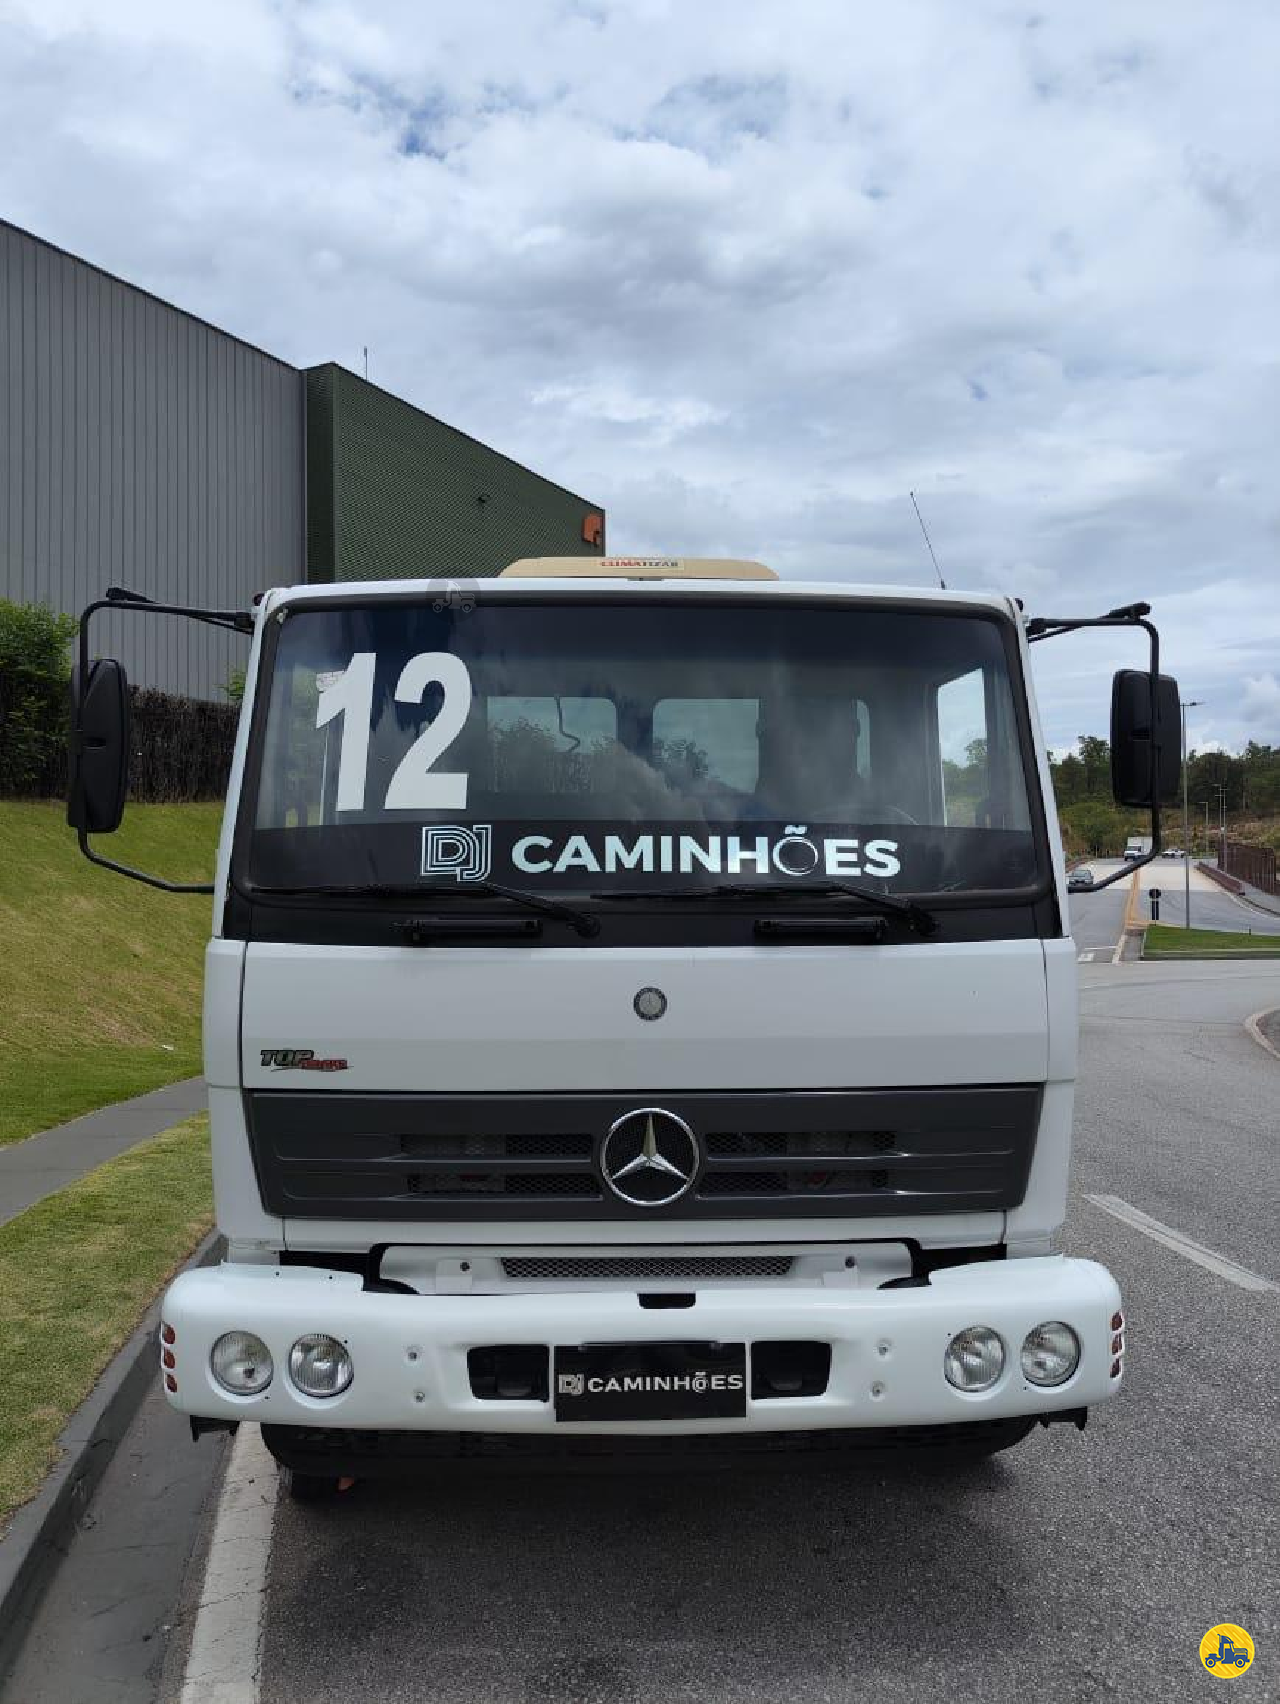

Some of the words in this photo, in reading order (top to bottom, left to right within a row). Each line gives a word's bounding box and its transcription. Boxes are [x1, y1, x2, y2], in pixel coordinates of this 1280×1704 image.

[316, 652, 472, 811] 12
[420, 825, 492, 882] DJ
[511, 825, 900, 877] CAMINHÕES
[260, 1050, 315, 1067] TOP
[587, 1371, 743, 1393] CAMINHÕES
